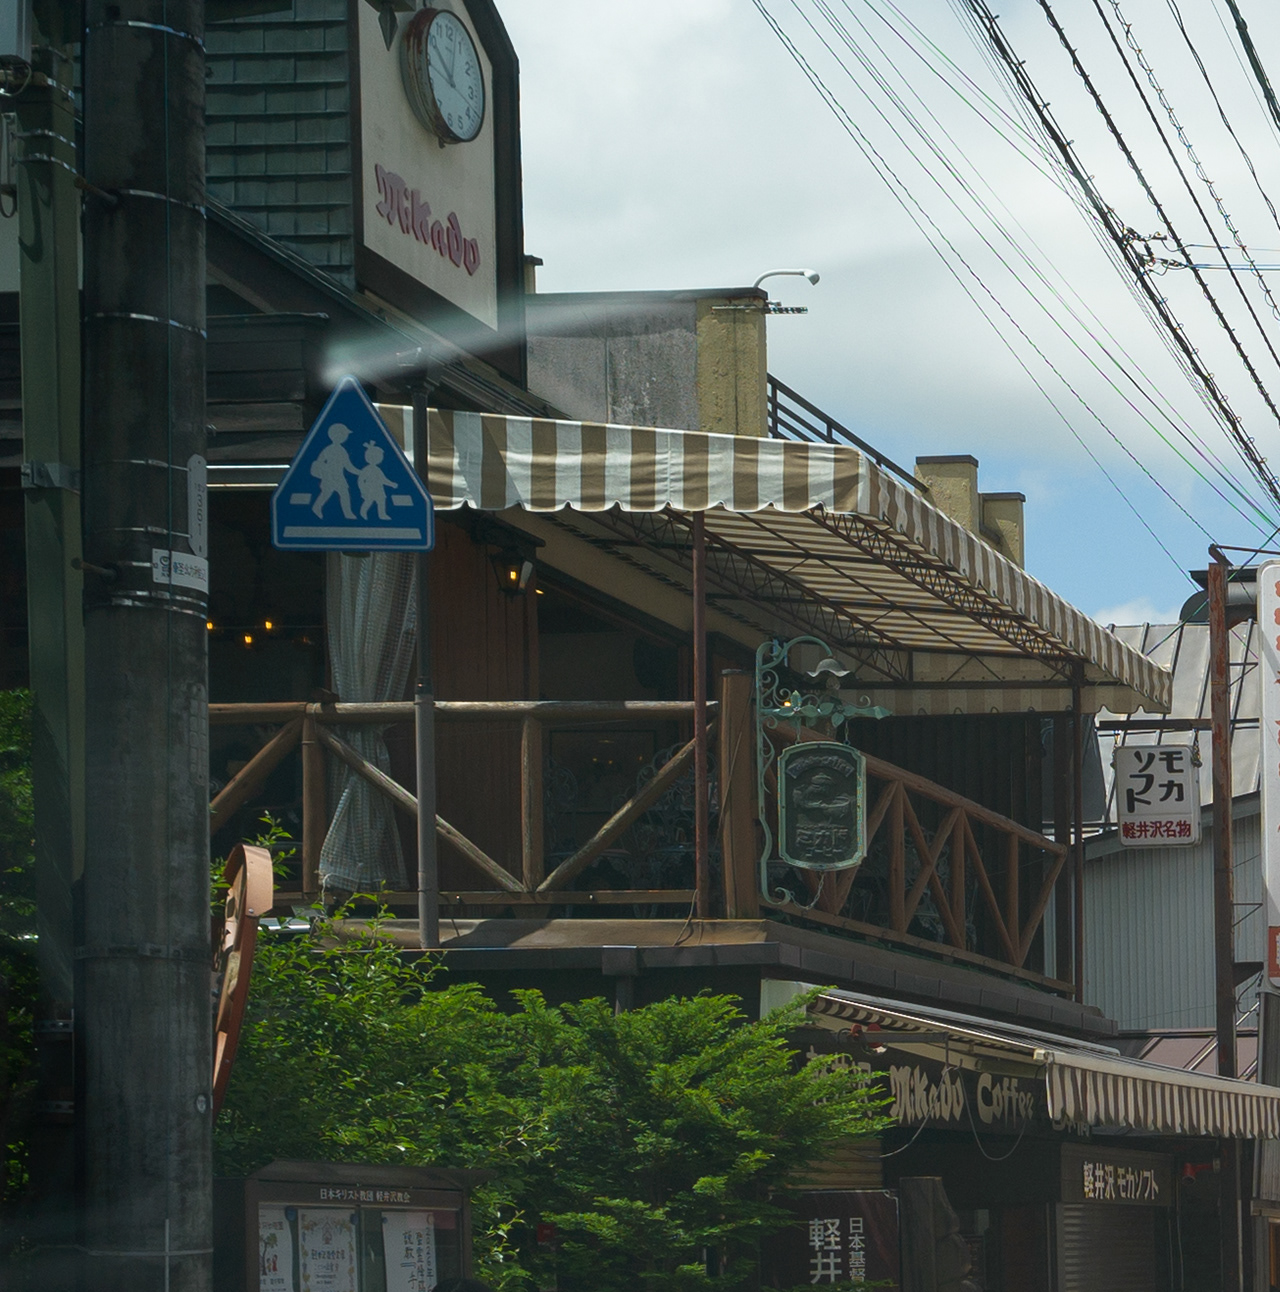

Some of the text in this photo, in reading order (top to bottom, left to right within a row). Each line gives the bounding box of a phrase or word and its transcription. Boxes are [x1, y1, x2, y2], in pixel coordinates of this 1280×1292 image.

[1126, 750, 1156, 814] ソフト
[1158, 750, 1185, 803] モカ
[1122, 819, 1192, 839] 軽井沢名物
[1083, 1160, 1160, 1201] 軽井沢 モカソフト
